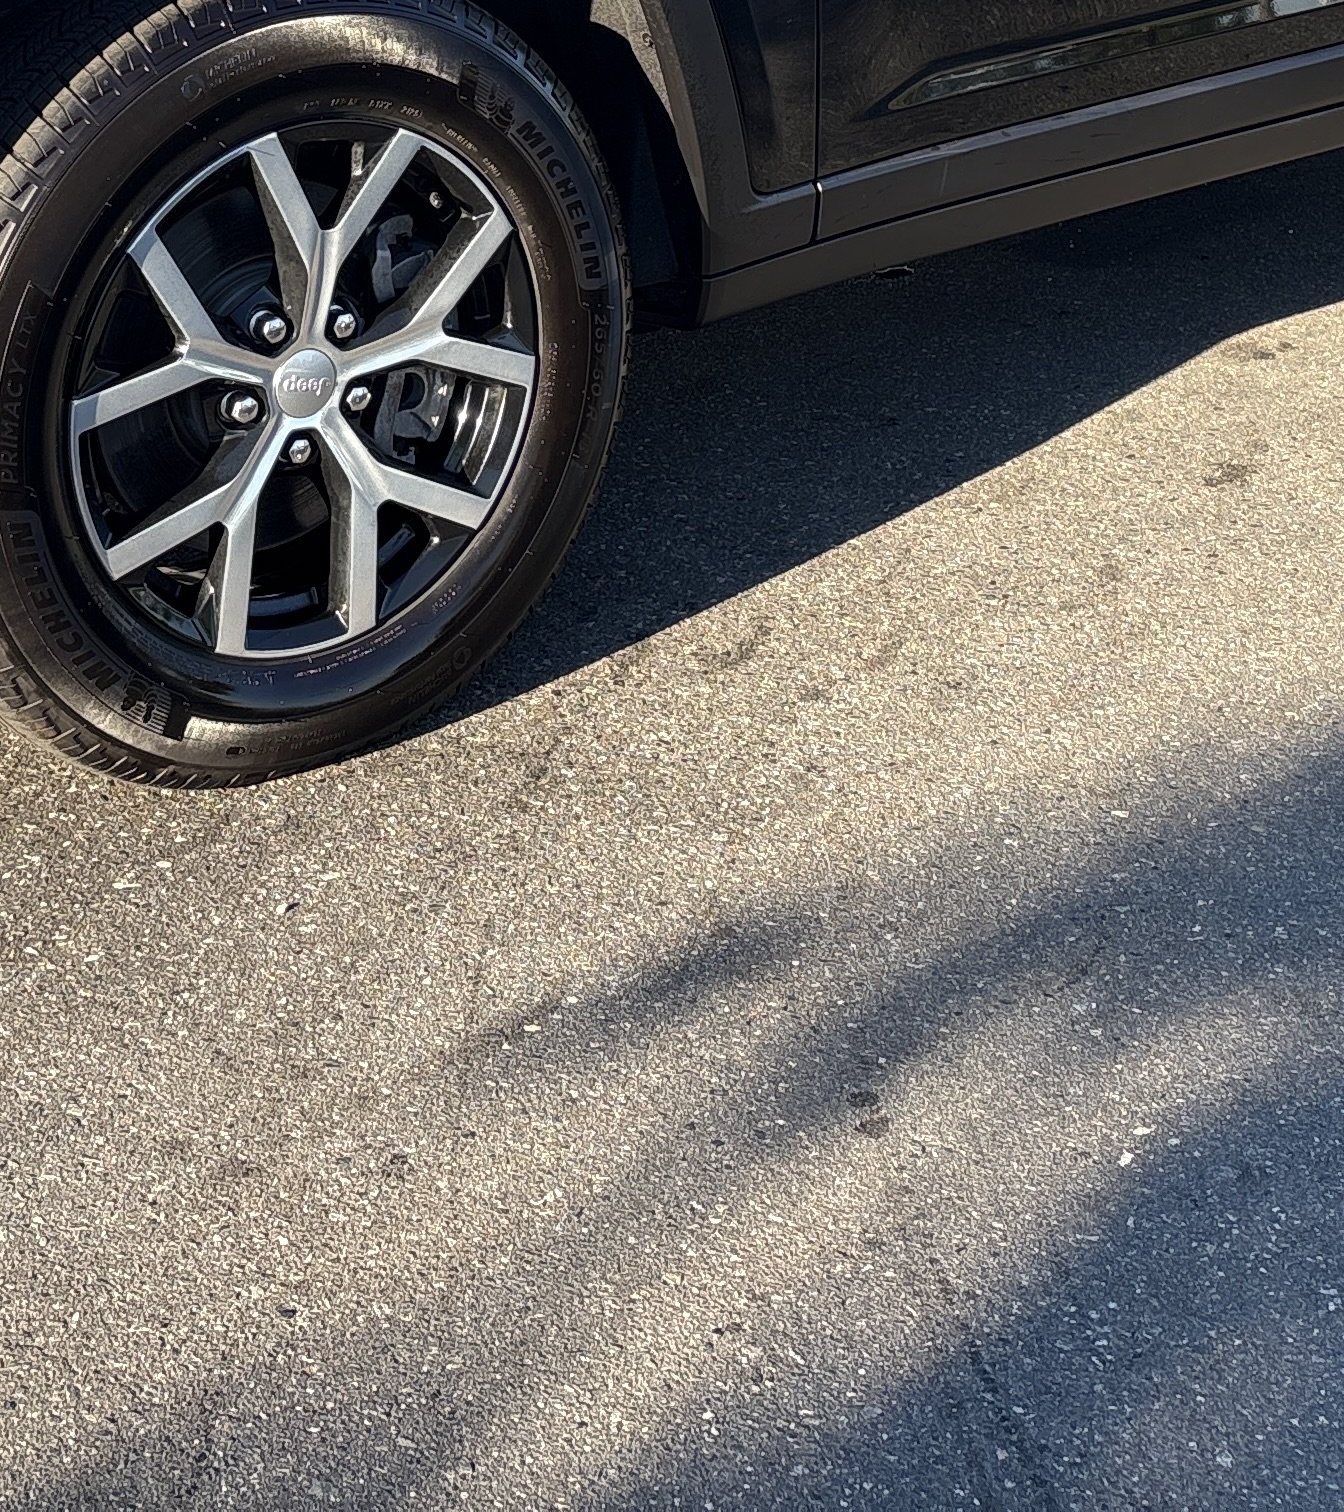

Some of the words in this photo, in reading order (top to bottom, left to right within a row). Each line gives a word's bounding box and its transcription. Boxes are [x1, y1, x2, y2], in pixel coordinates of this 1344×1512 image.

[516, 120, 602, 279] MICHELIN
[0, 357, 27, 485] PRIMACY
[15, 313, 37, 349] LTX
[9, 522, 122, 691] MICHELIN
